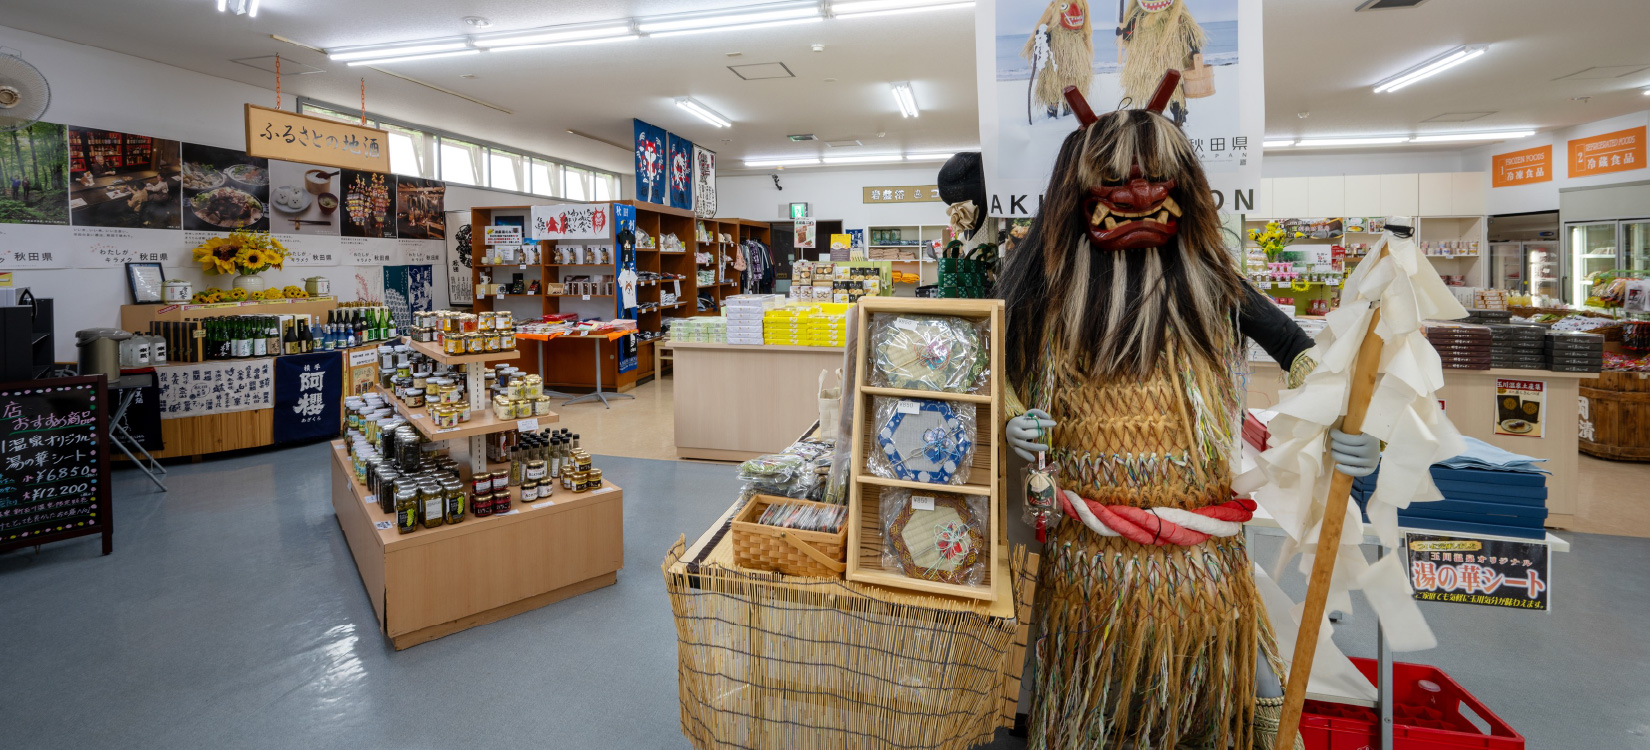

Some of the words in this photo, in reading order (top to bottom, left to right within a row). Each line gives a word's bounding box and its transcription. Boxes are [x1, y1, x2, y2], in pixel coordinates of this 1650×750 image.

[259, 122, 380, 159] ふるさとの地酒
[1189, 136, 1248, 153] 秋田県
[1618, 135, 1636, 146] FOODS
[1505, 155, 1525, 166] FROZEN
[1526, 152, 1545, 162] FOODS
[1577, 151, 1584, 163] 2
[1587, 152, 1635, 170] 冷蔵食品
[1506, 167, 1545, 181] 冷凍食品
[871, 189, 905, 201] 岩盤浴
[14, 252, 53, 262] 秋田県
[139, 253, 168, 261] 秋田県
[312, 254, 333, 262] 秋田県
[303, 362, 321, 372] 横手
[2, 400, 23, 418] 店
[12, 410, 92, 431] おすすめ商品
[300, 415, 322, 423] あざくら
[5, 449, 87, 471] 湯の華シート
[22, 490, 32, 501] 大
[1430, 551, 1533, 567] 玉川温泉オリジナル
[1414, 562, 1545, 598] 湯の華シート
[1415, 592, 1545, 609] ご家庭でも気軽に玉川気分が味わえます。
